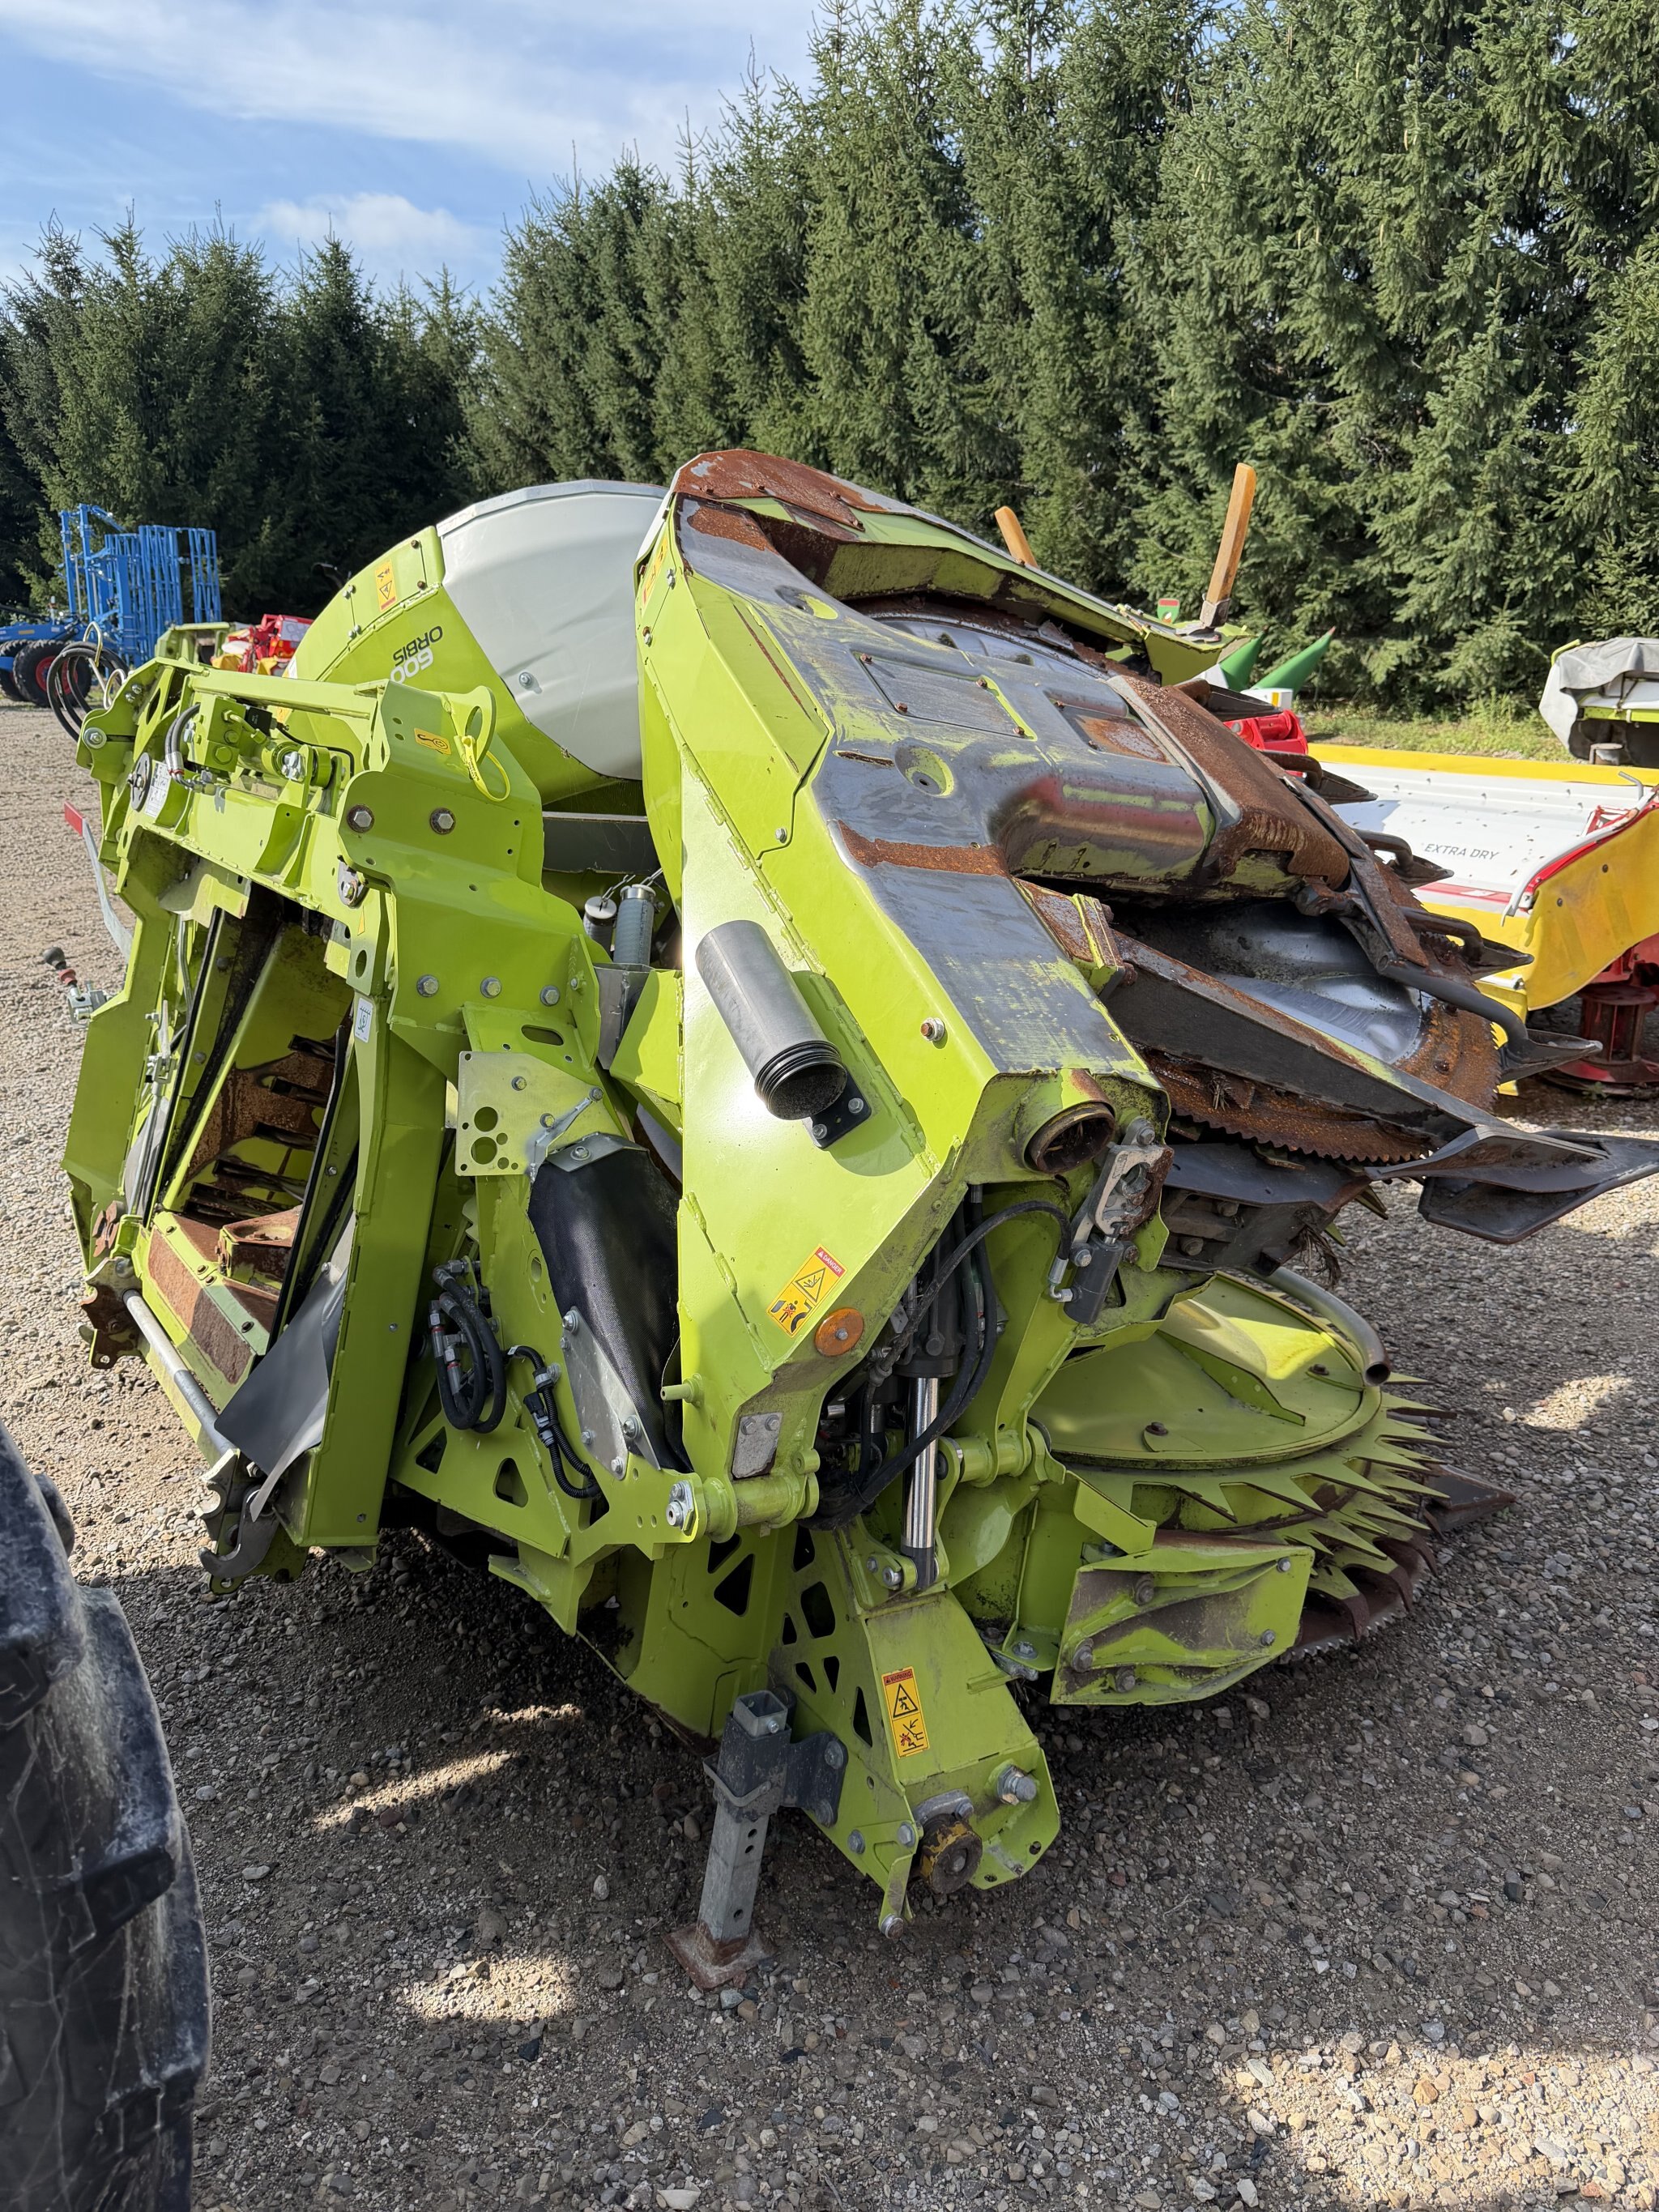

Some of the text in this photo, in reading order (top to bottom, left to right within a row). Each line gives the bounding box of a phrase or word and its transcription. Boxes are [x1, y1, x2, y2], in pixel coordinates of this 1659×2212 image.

[393, 626, 443, 667] ORBIS
[390, 647, 433, 684] 600
[1425, 843, 1499, 860] EXTRA DRY
[822, 1255, 842, 1275] DANGER
[890, 1671, 912, 1681] WARNING
